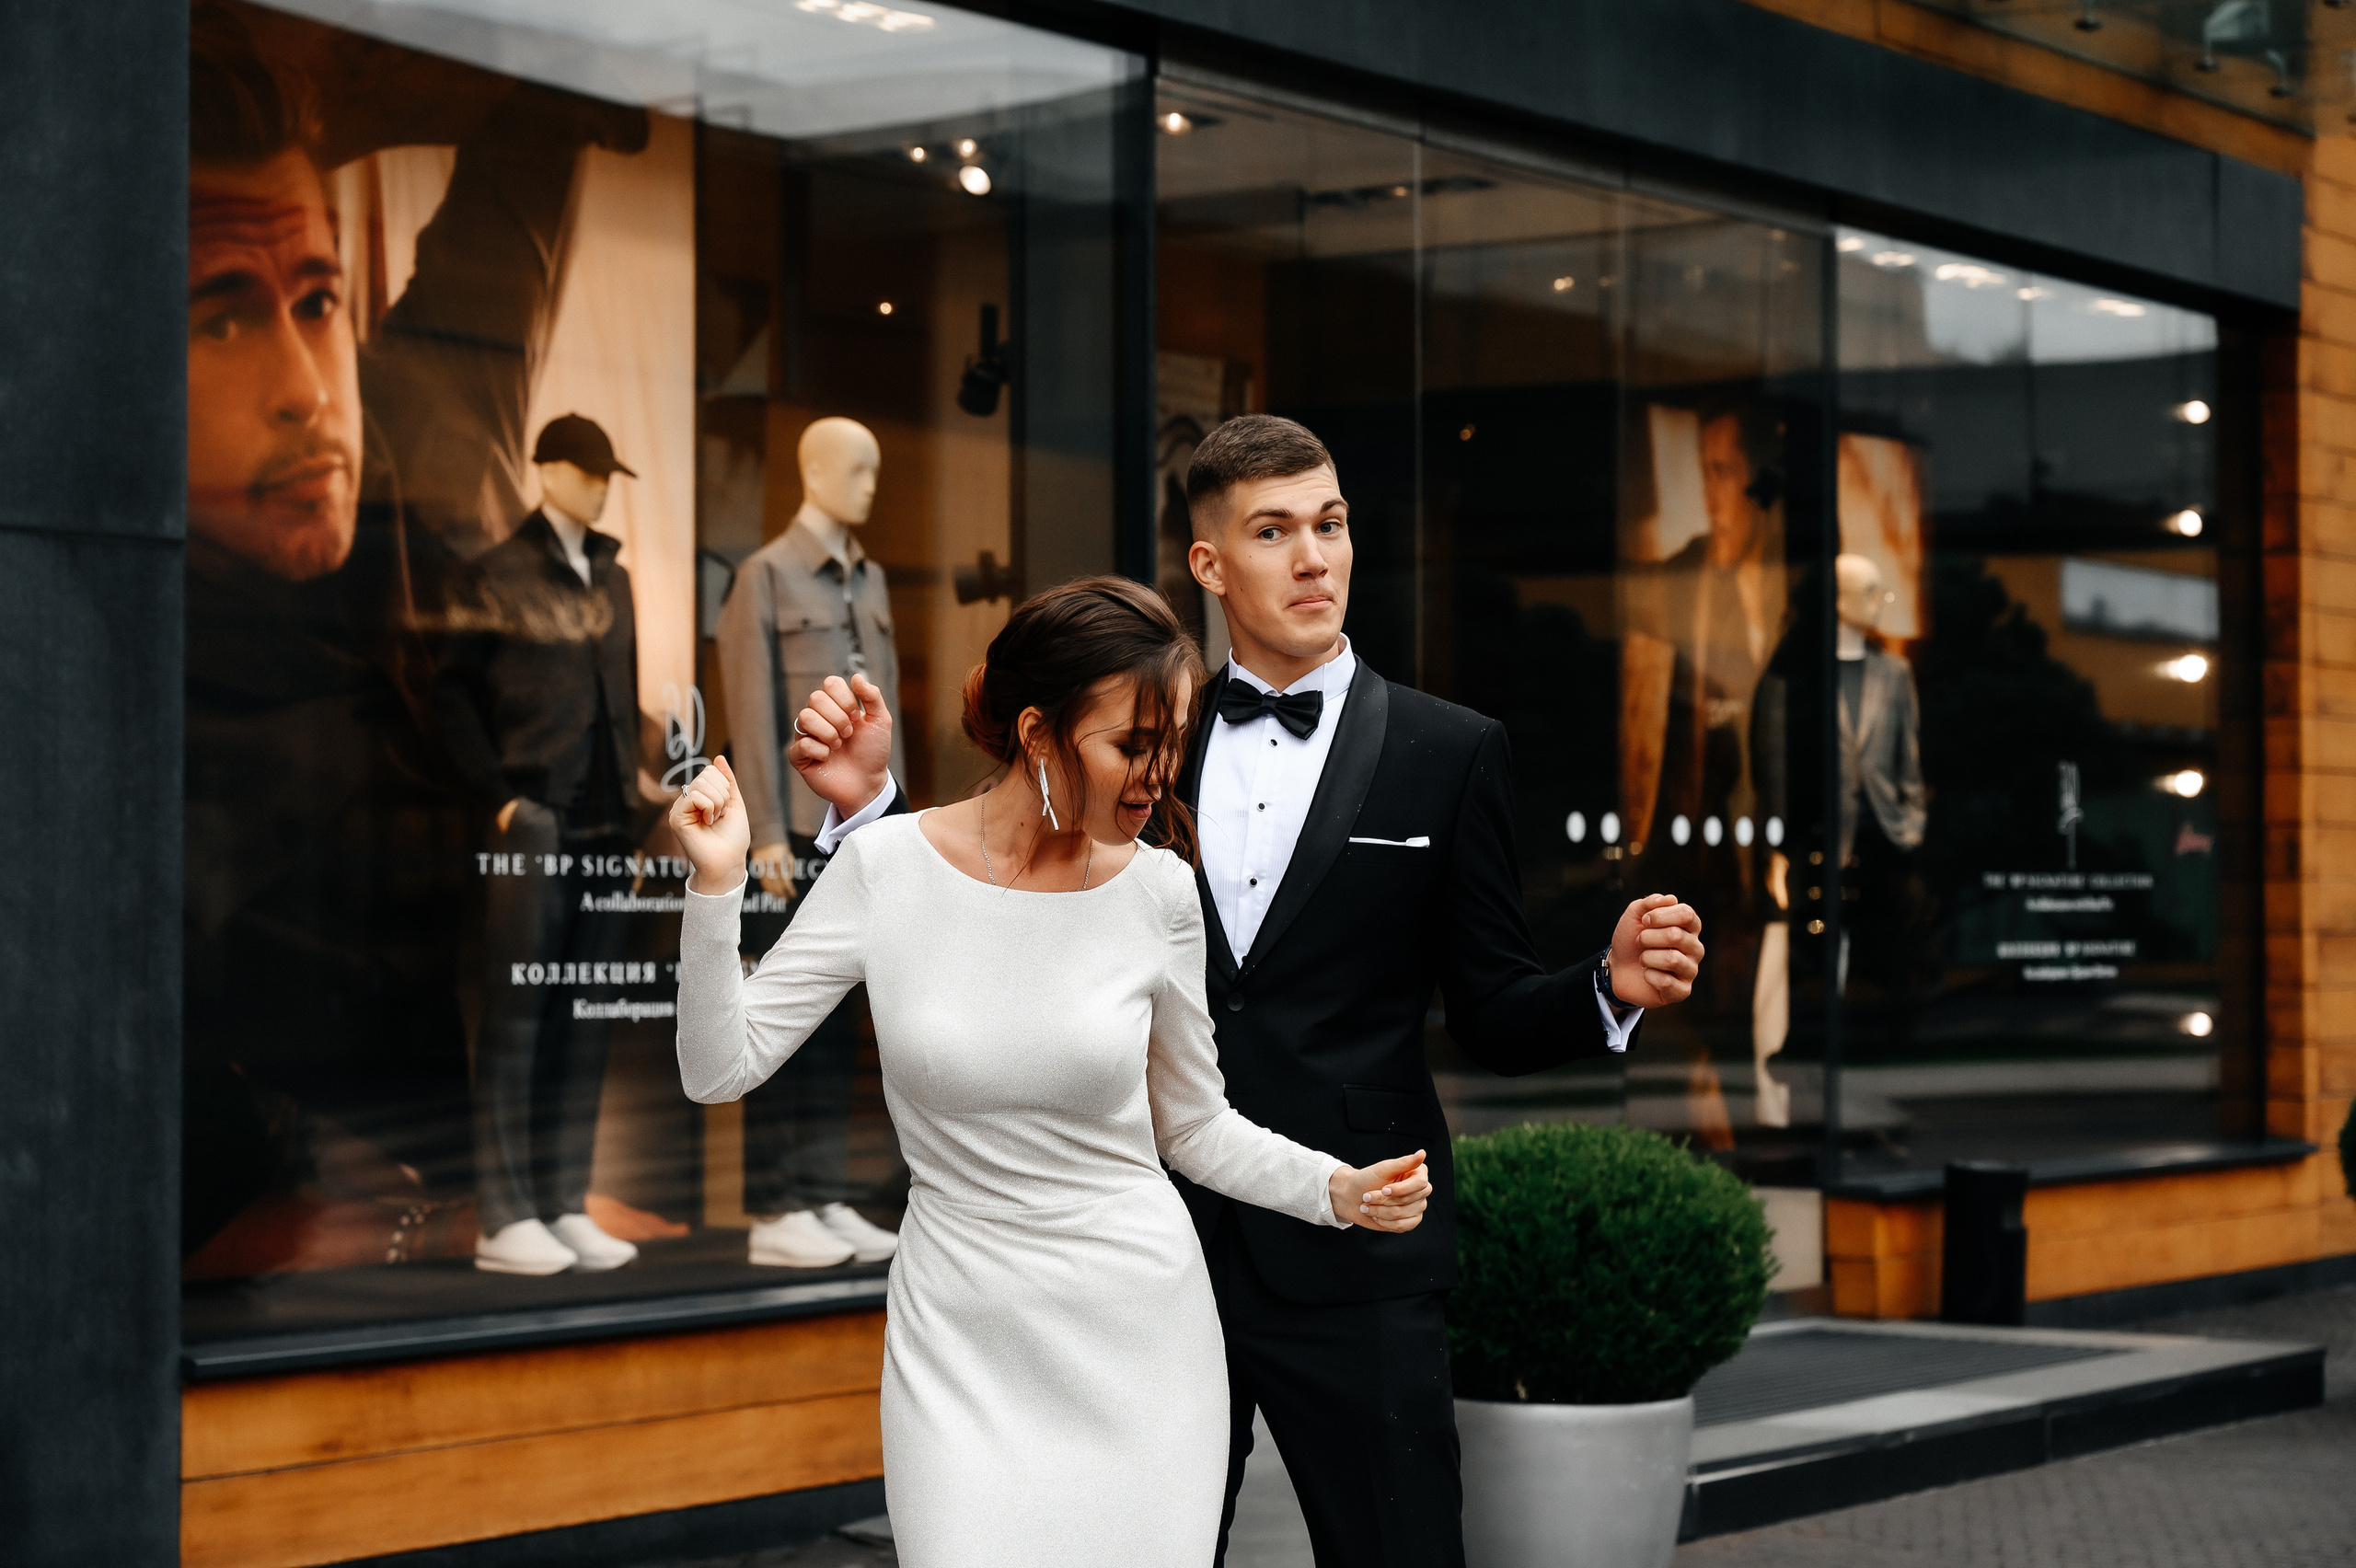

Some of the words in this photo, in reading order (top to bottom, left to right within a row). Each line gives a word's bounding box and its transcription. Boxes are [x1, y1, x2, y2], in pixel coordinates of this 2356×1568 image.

[475, 852, 526, 876] THE
[580, 854, 696, 878] SIGNATU
[746, 858, 828, 880] OLLEC
[511, 961, 656, 986] КОЛЛЕКЦИЯ
